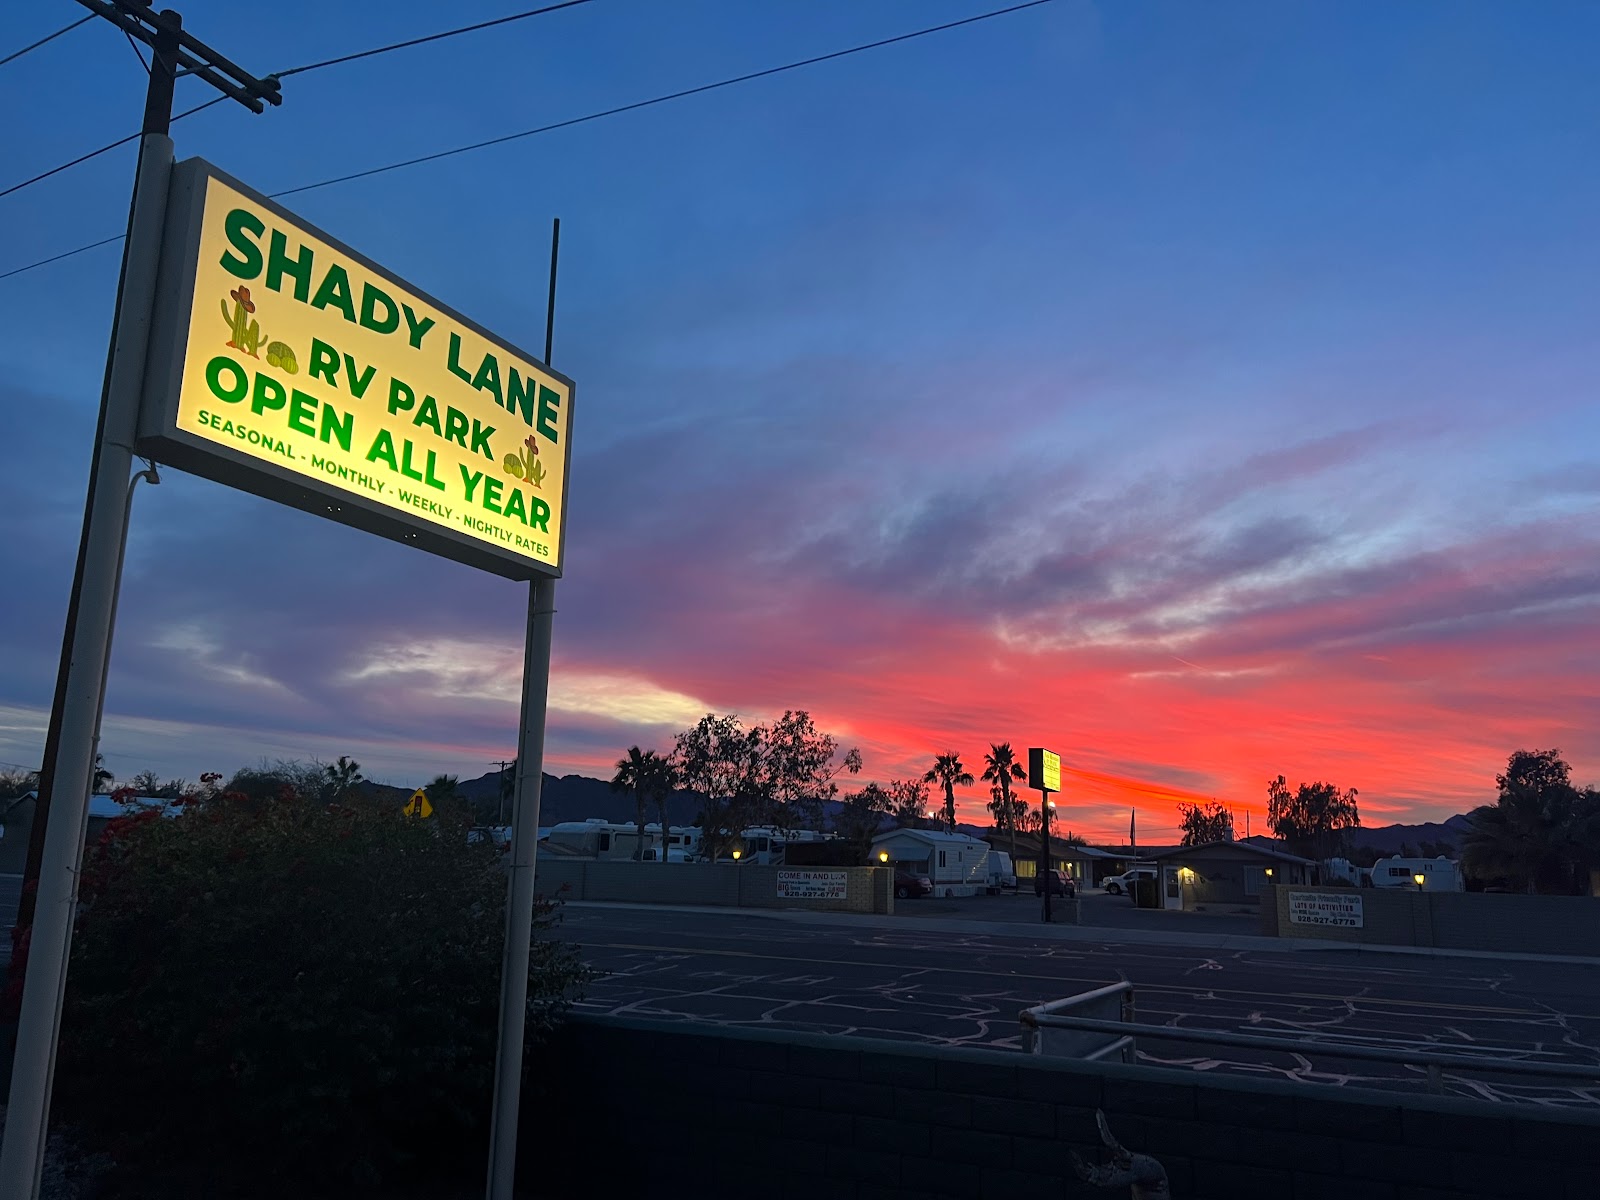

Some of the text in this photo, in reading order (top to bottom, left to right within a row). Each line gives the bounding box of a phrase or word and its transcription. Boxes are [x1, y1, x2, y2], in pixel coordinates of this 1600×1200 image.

[219, 208, 561, 444] SHADY LANE
[205, 356, 551, 534] OPEN ALL YEAR
[309, 337, 496, 461] RV PARK
[198, 410, 296, 460] SEASONAL
[311, 454, 385, 493] MONTHLY
[398, 488, 453, 519] WEEKLY
[463, 514, 512, 543] NIGHTLY
[515, 535, 549, 557] RATES
[778, 884, 789, 892] BIG
[1297, 916, 1356, 926] 928-927-6778
[1318, 903, 1353, 912] ACTIVITIES
